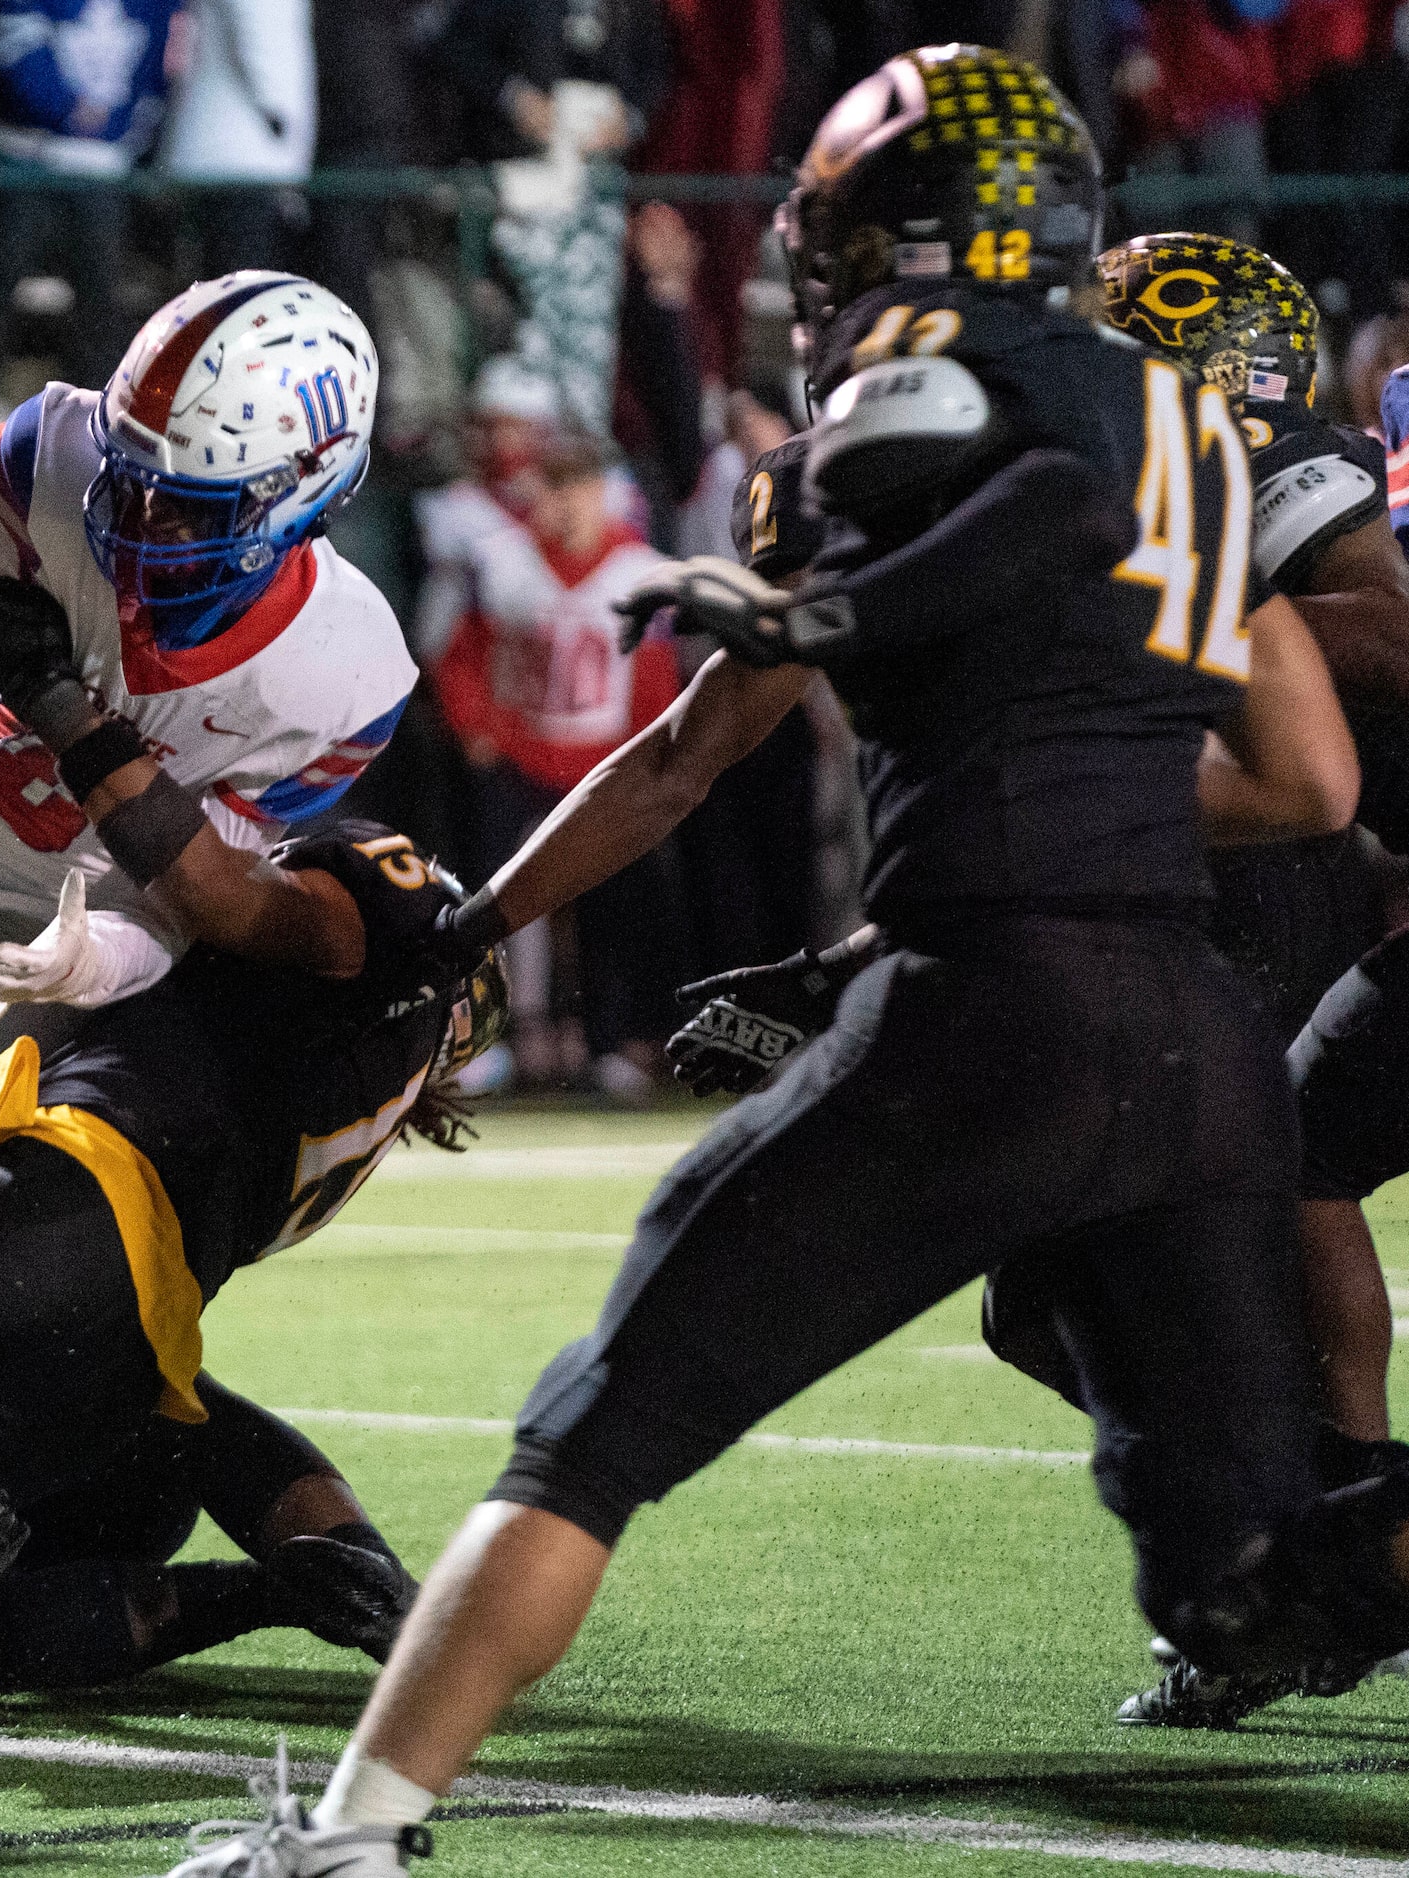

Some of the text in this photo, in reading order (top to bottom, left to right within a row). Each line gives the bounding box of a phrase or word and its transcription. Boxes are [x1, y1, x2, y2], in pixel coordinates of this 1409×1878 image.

[964, 228, 1032, 280] 42
[294, 364, 349, 448] 10
[748, 471, 778, 556] 2
[1109, 357, 1252, 684] 42
[351, 833, 440, 891] 15
